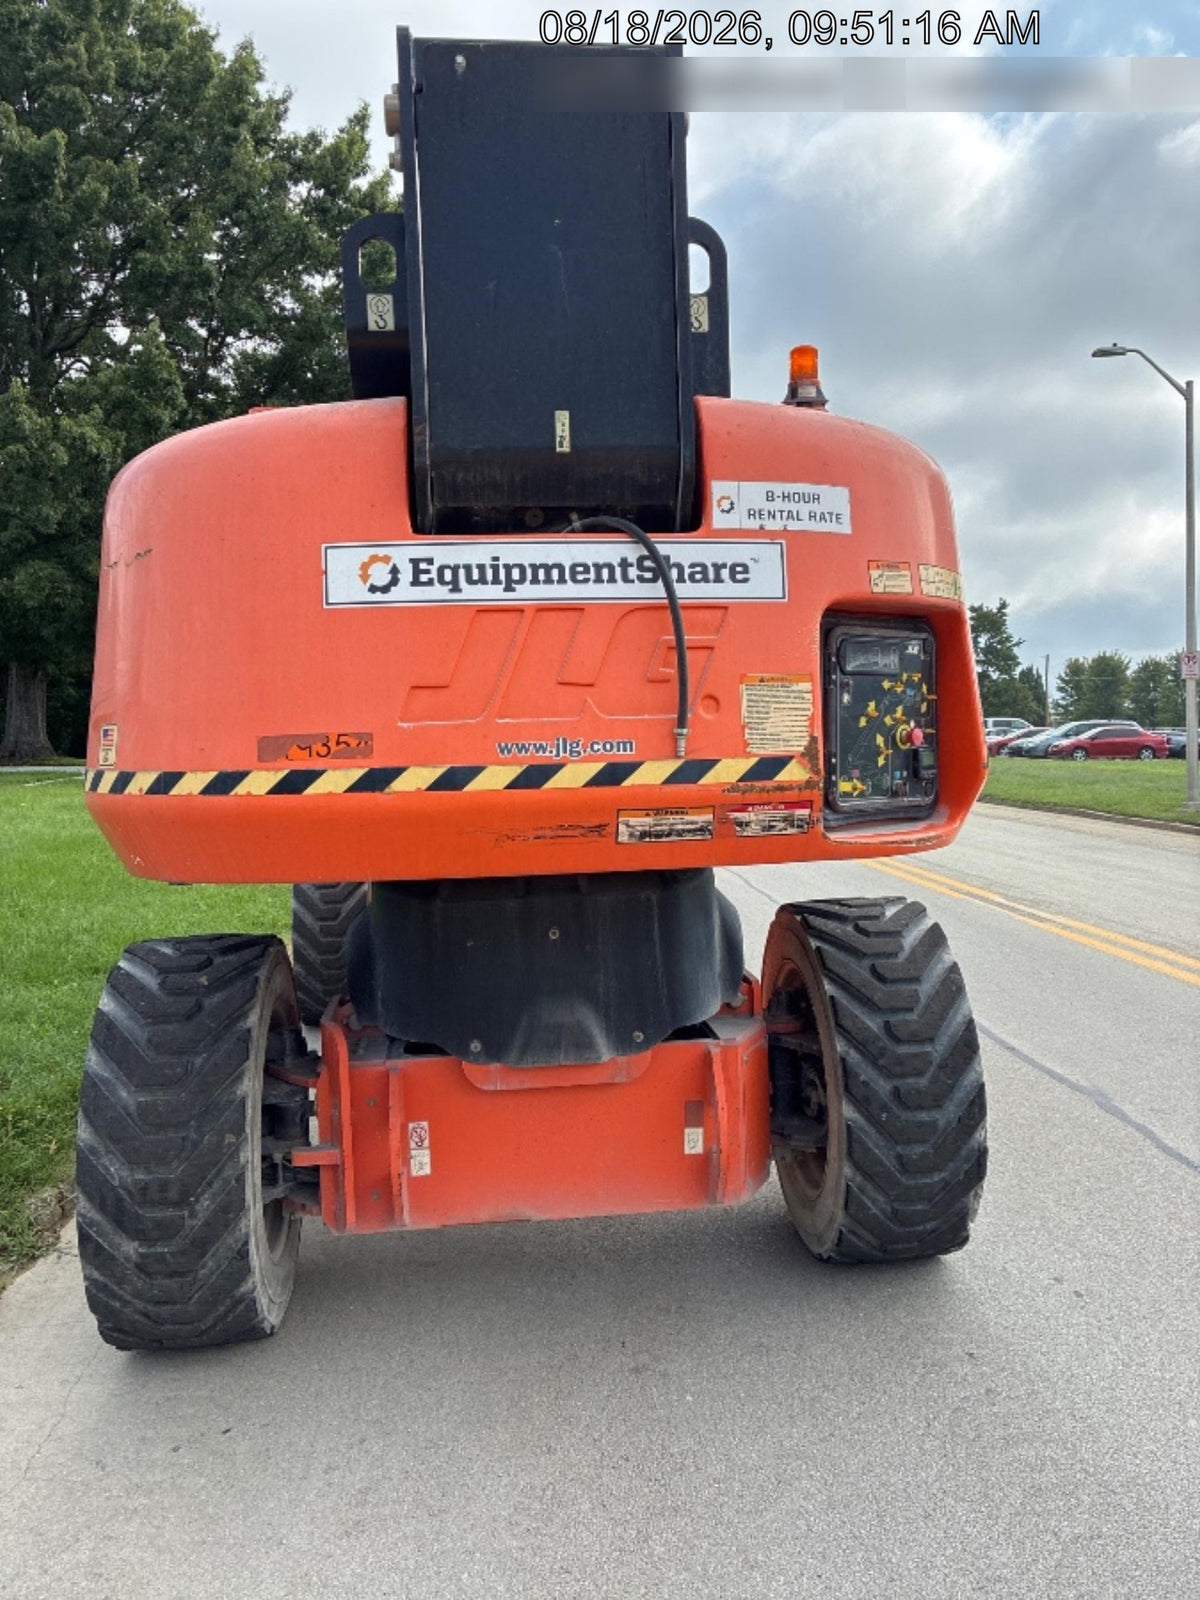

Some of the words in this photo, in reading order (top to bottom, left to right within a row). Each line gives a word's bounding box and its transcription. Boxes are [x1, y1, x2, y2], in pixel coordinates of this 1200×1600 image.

[747, 508, 804, 522] RENTAL
[808, 510, 844, 525] RATE
[497, 737, 635, 759] www.jlg.com
